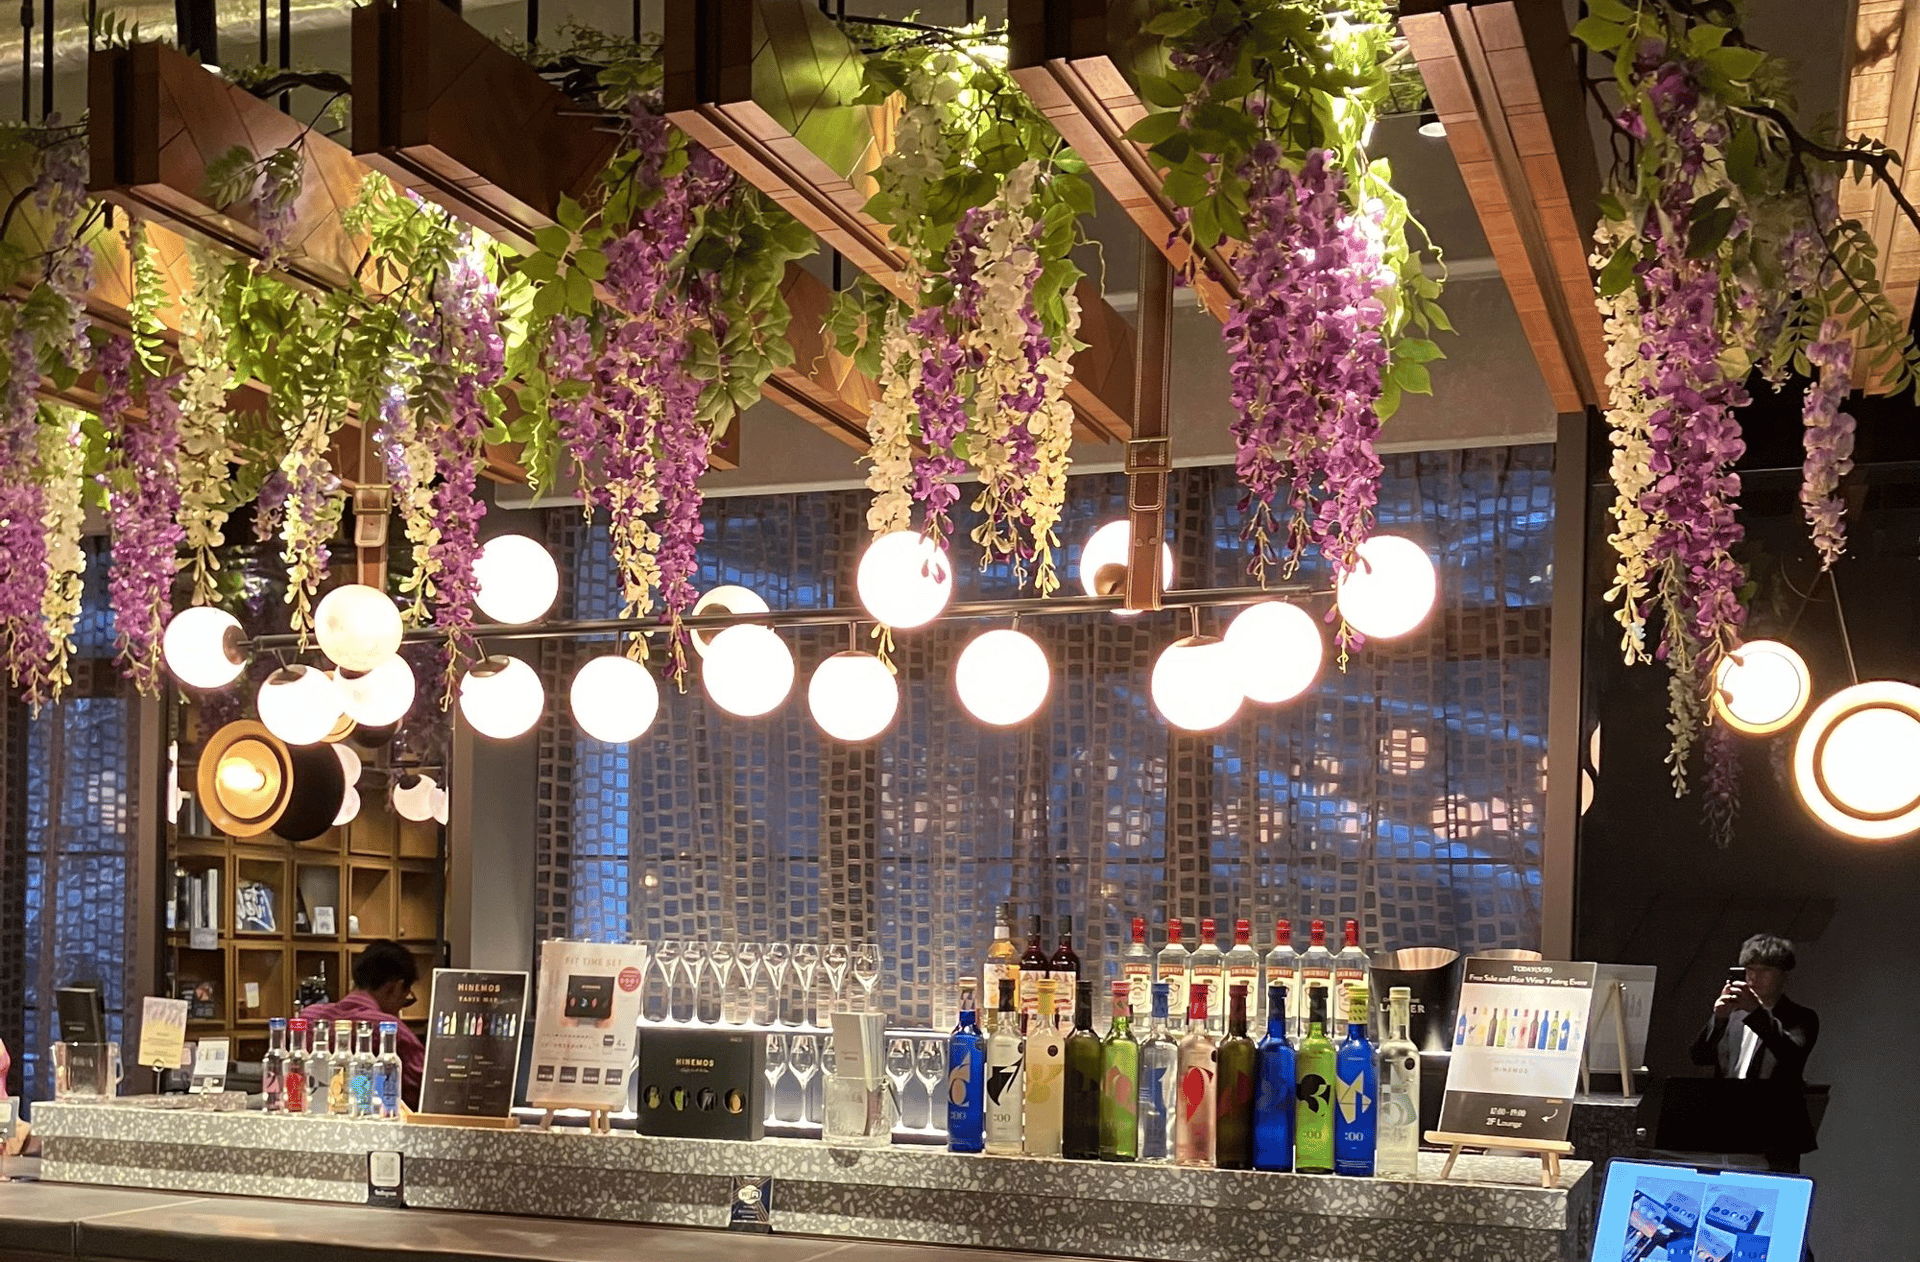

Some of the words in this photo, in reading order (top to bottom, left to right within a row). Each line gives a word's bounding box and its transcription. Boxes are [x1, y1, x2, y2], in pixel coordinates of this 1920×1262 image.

[1525, 976, 1544, 984] Wine
[457, 983, 501, 992] HINEMOS
[676, 1058, 714, 1067] HINEMOS
[1497, 1118, 1522, 1128] Lounge
